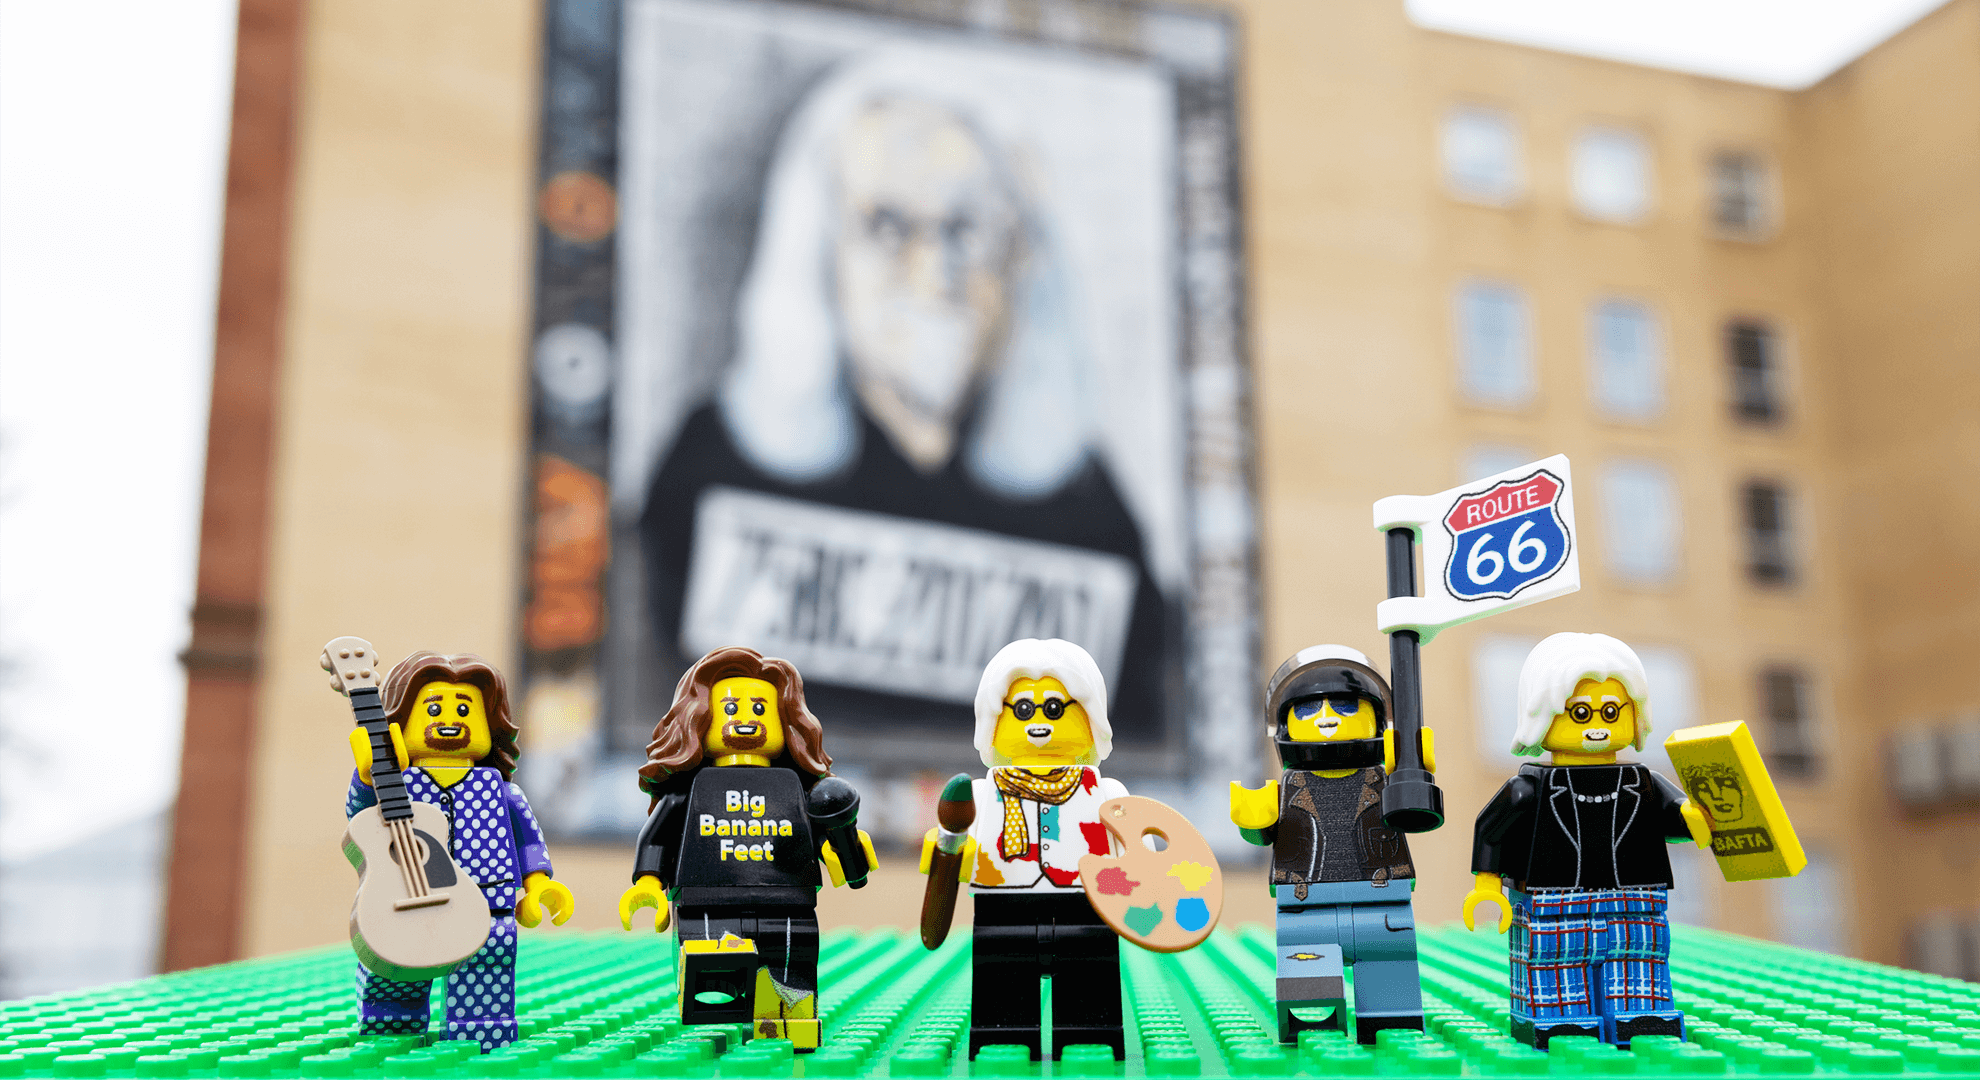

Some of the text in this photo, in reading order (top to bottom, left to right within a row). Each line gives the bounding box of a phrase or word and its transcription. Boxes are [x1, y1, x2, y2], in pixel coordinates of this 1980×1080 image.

[1466, 484, 1540, 525] ROUTE
[1466, 520, 1547, 585] 66
[725, 789, 766, 818] Big
[699, 814, 793, 837] Banana
[720, 839, 774, 862] Feet
[1714, 833, 1768, 851] BAFTA
